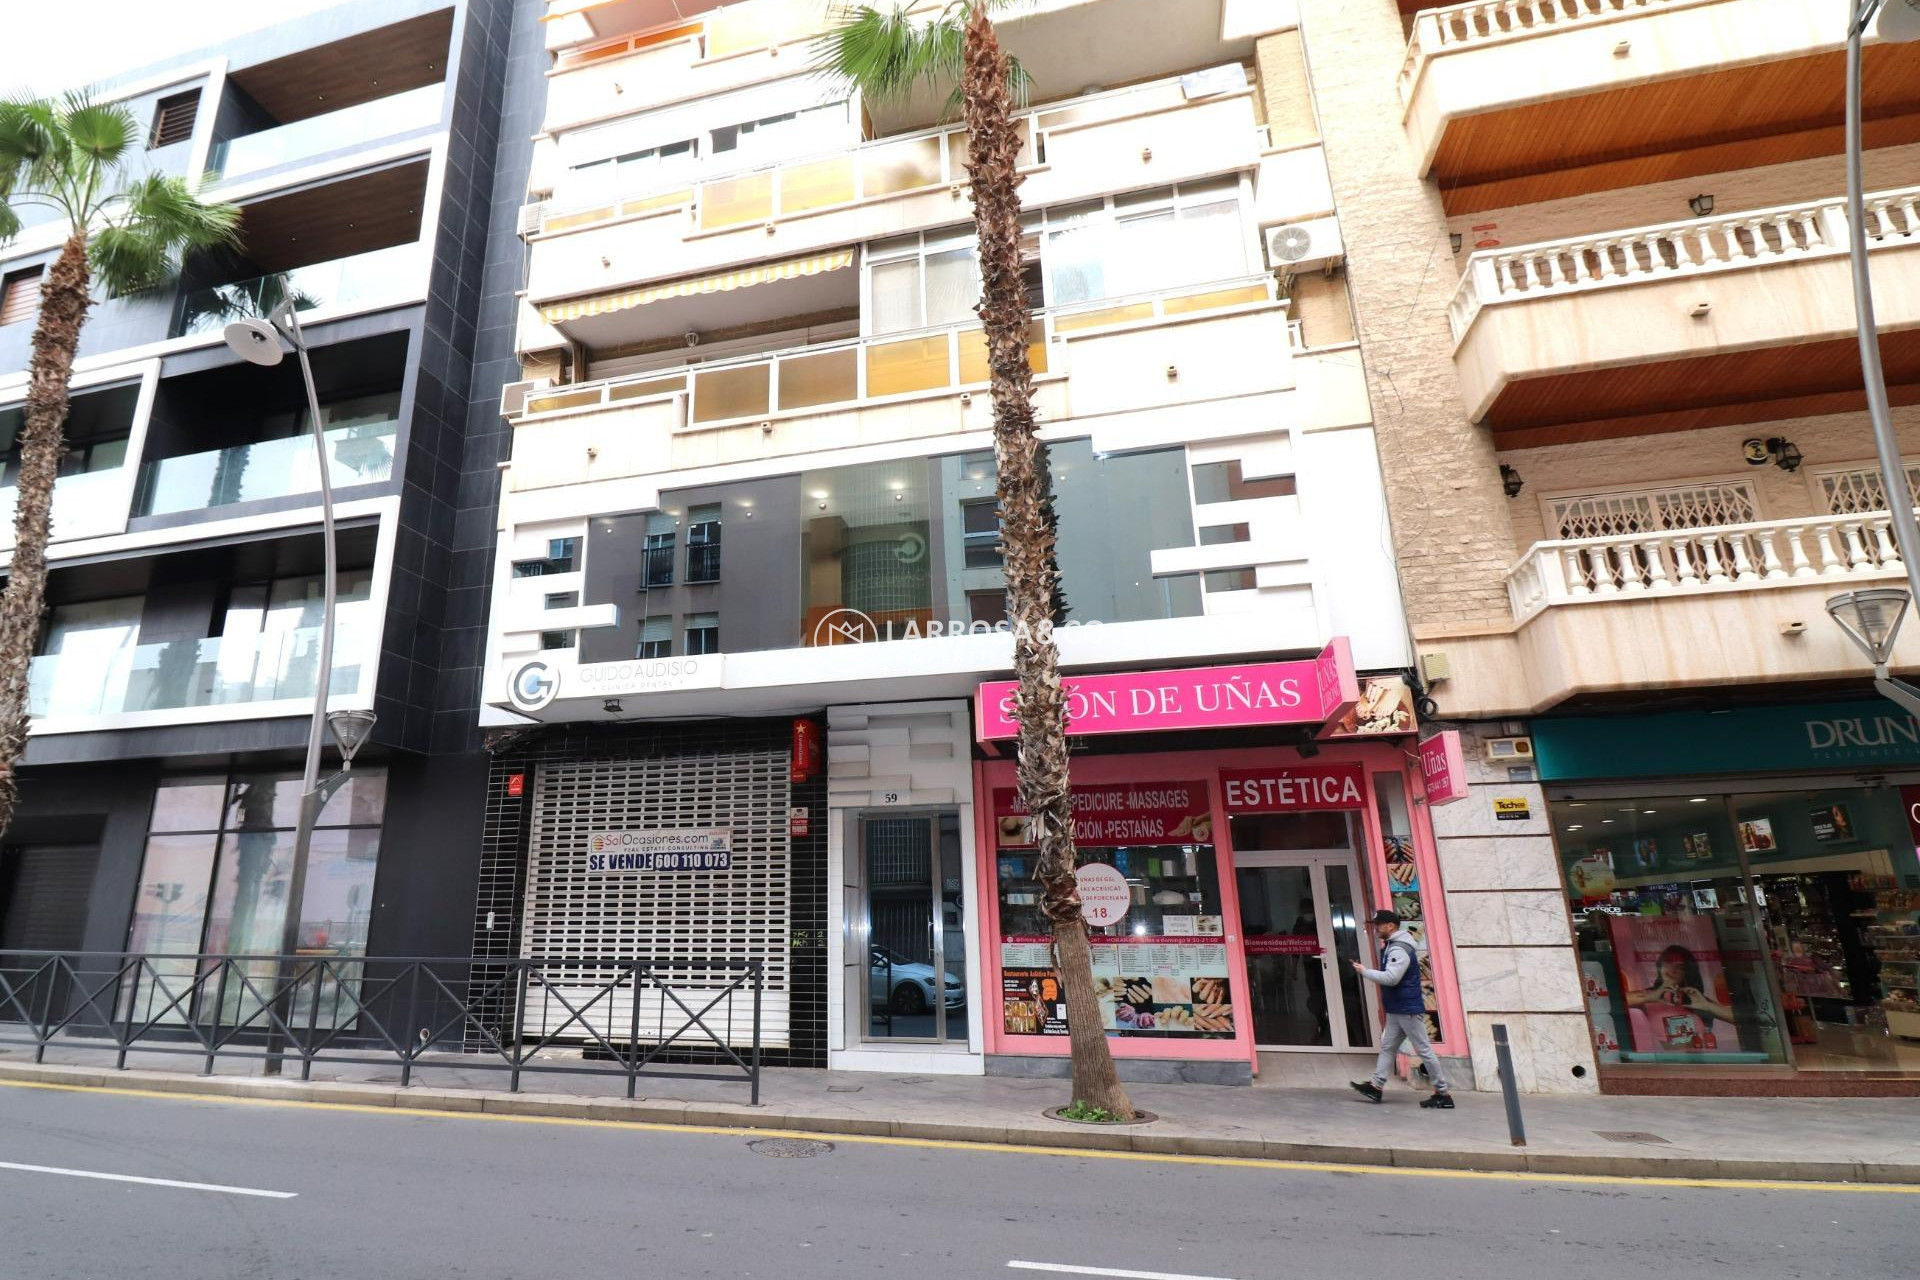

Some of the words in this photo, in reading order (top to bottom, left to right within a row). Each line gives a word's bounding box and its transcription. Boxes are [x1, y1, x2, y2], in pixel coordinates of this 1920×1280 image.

[999, 684, 1116, 724] SÓN
[1129, 686, 1182, 716] DE
[1193, 675, 1302, 712] UÑAS
[1805, 714, 1920, 749] DRUN
[1422, 750, 1447, 777] Uñas
[885, 793, 898, 804] 59
[1225, 771, 1362, 806] ESTÉTICA
[605, 833, 709, 846] SolOcasiones.com
[589, 854, 605, 870] SE
[609, 853, 653, 870] VENDE
[655, 853, 679, 868] 600
[682, 853, 701, 868] 110
[704, 852, 728, 867] 073
[1092, 907, 1108, 918] 18
